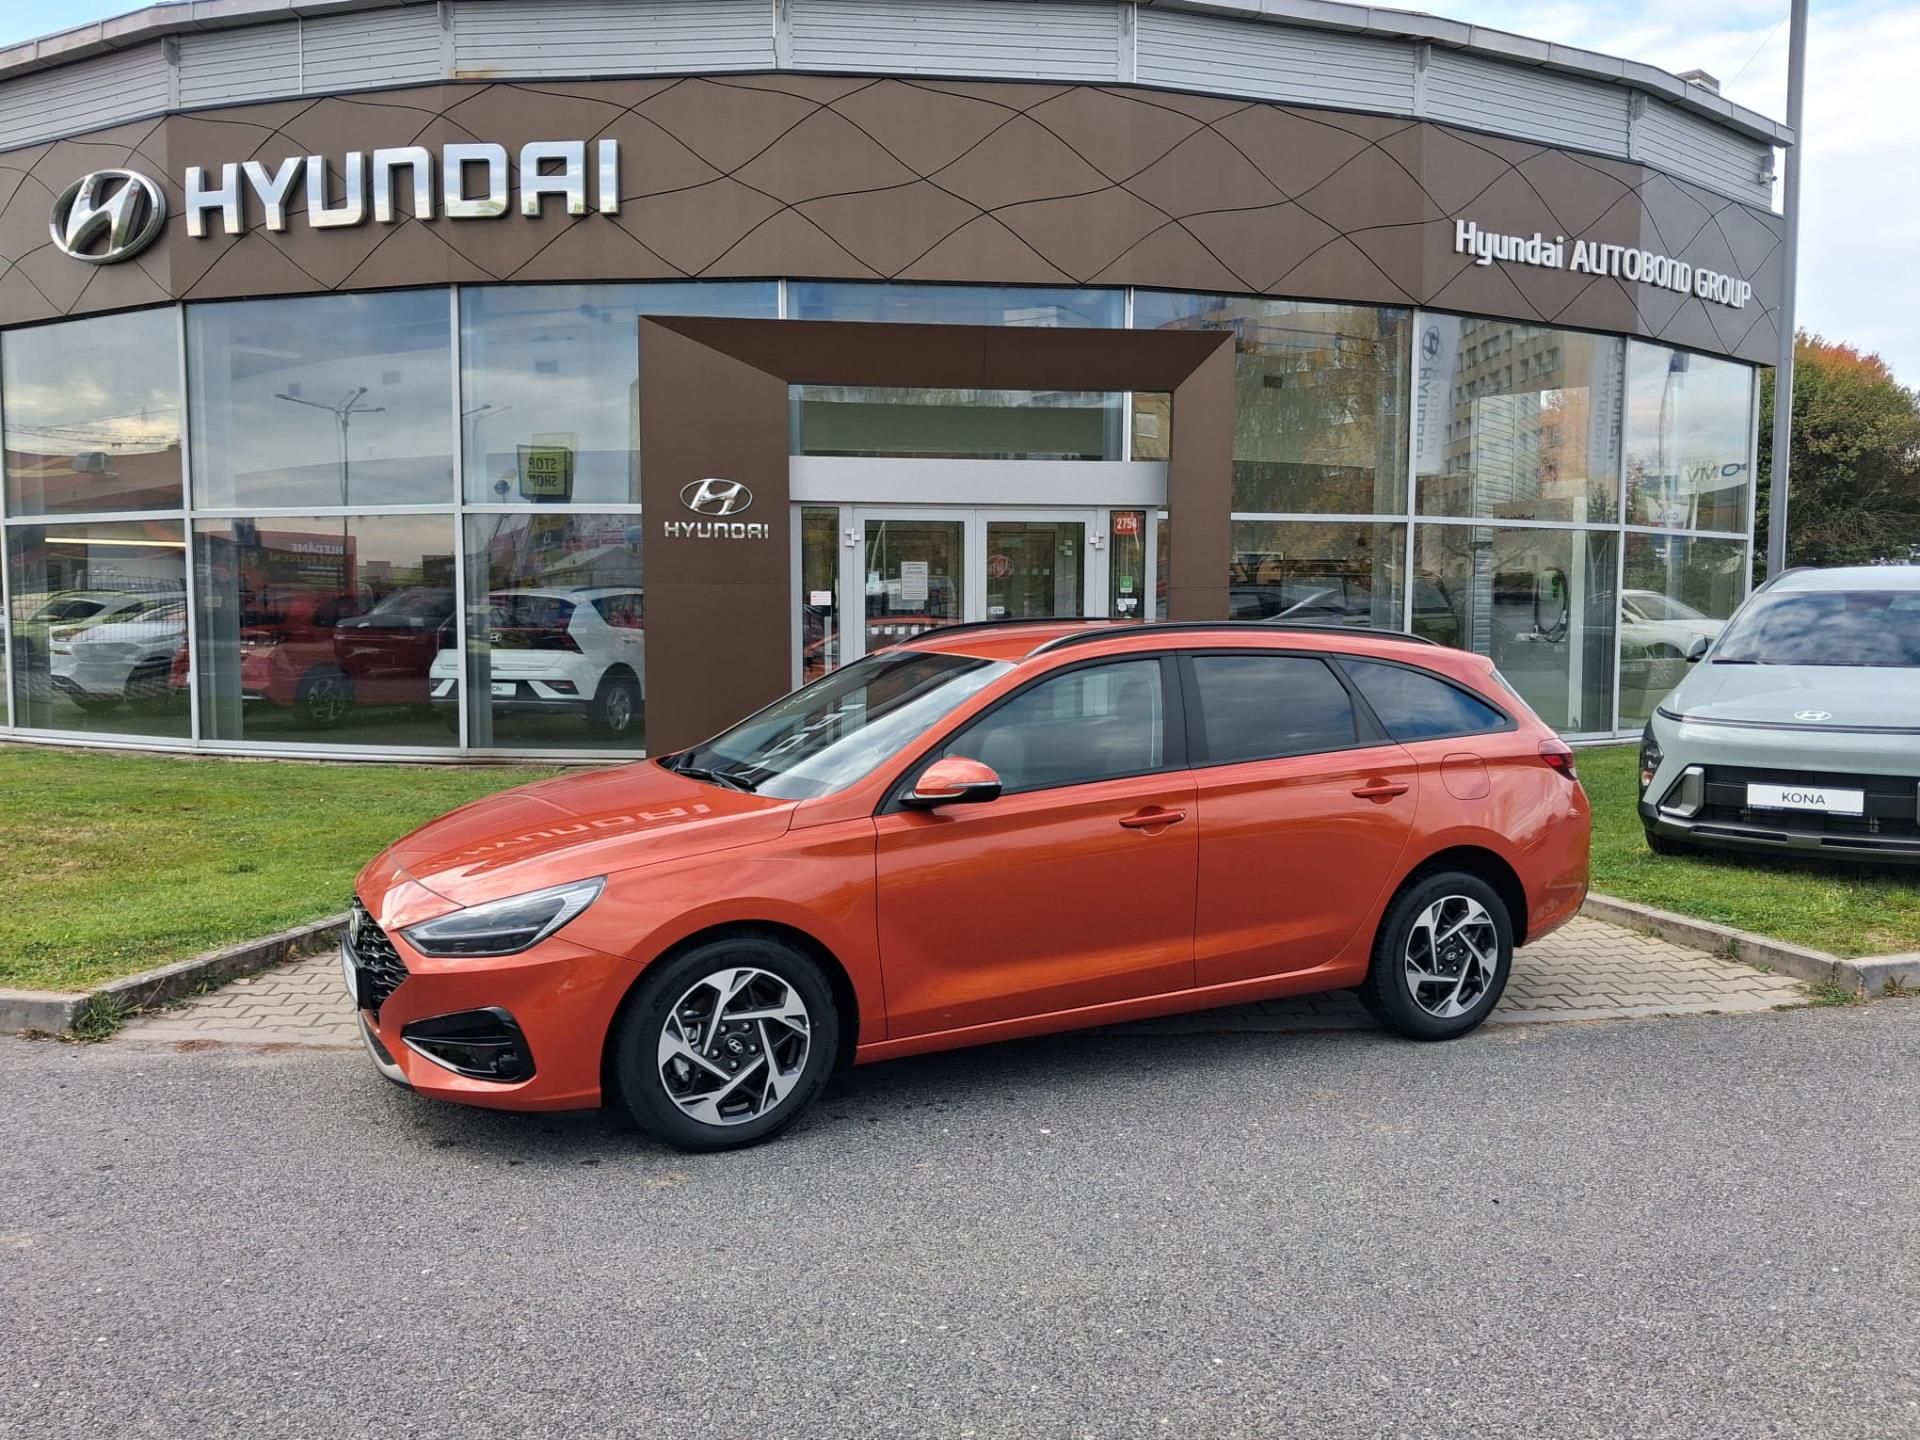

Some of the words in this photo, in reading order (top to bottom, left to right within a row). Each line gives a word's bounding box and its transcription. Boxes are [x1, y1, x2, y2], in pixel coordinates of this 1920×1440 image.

[184, 139, 620, 238] HYUNDAI
[1455, 219, 1564, 268] Hyundai
[1569, 239, 1692, 294] AUTOBOND
[1694, 267, 1752, 309] GROUP
[664, 521, 769, 539] HYUNDAI
[1782, 792, 1826, 806] KONA
